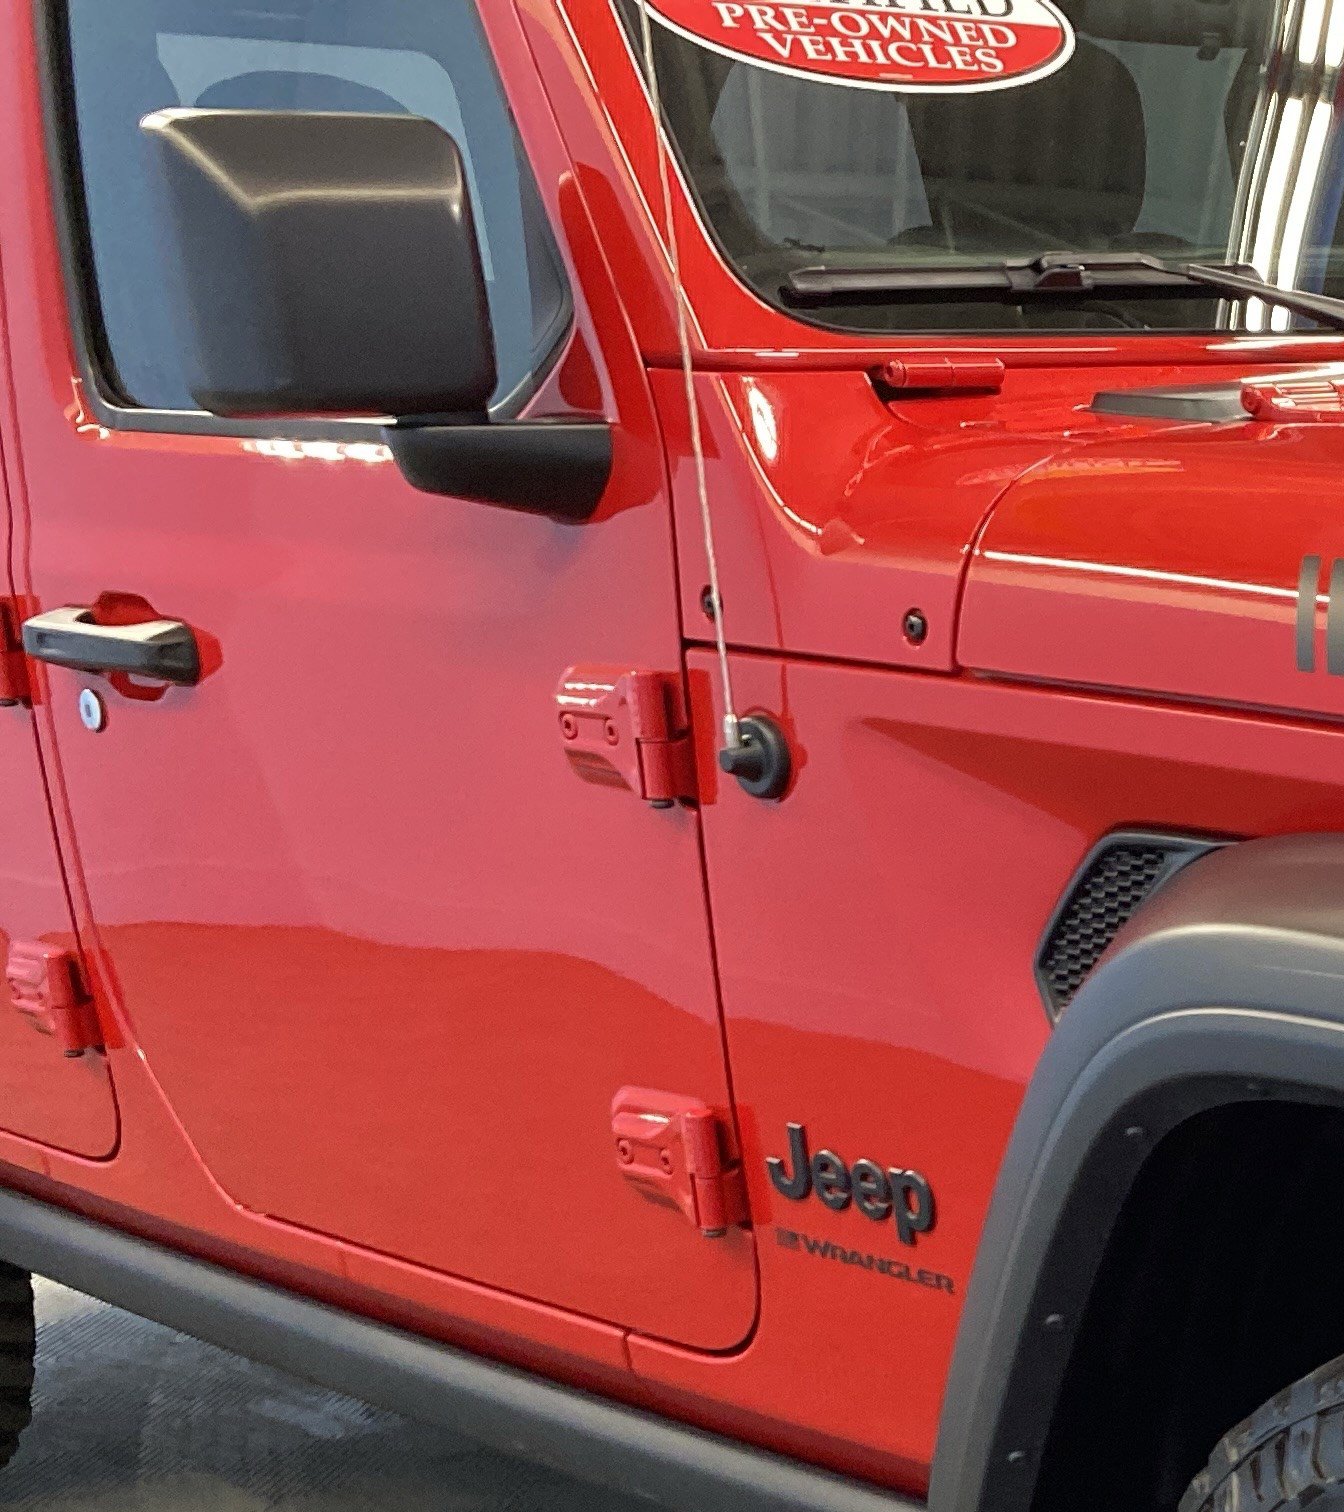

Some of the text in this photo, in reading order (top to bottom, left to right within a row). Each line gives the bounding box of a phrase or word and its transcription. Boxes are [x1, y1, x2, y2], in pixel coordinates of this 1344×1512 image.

[713, 2, 1018, 49] PRE-OWNED
[755, 31, 1005, 74] VEHICLES
[765, 1121, 937, 1246] Jeep
[801, 1232, 955, 1294] WRANGLER
